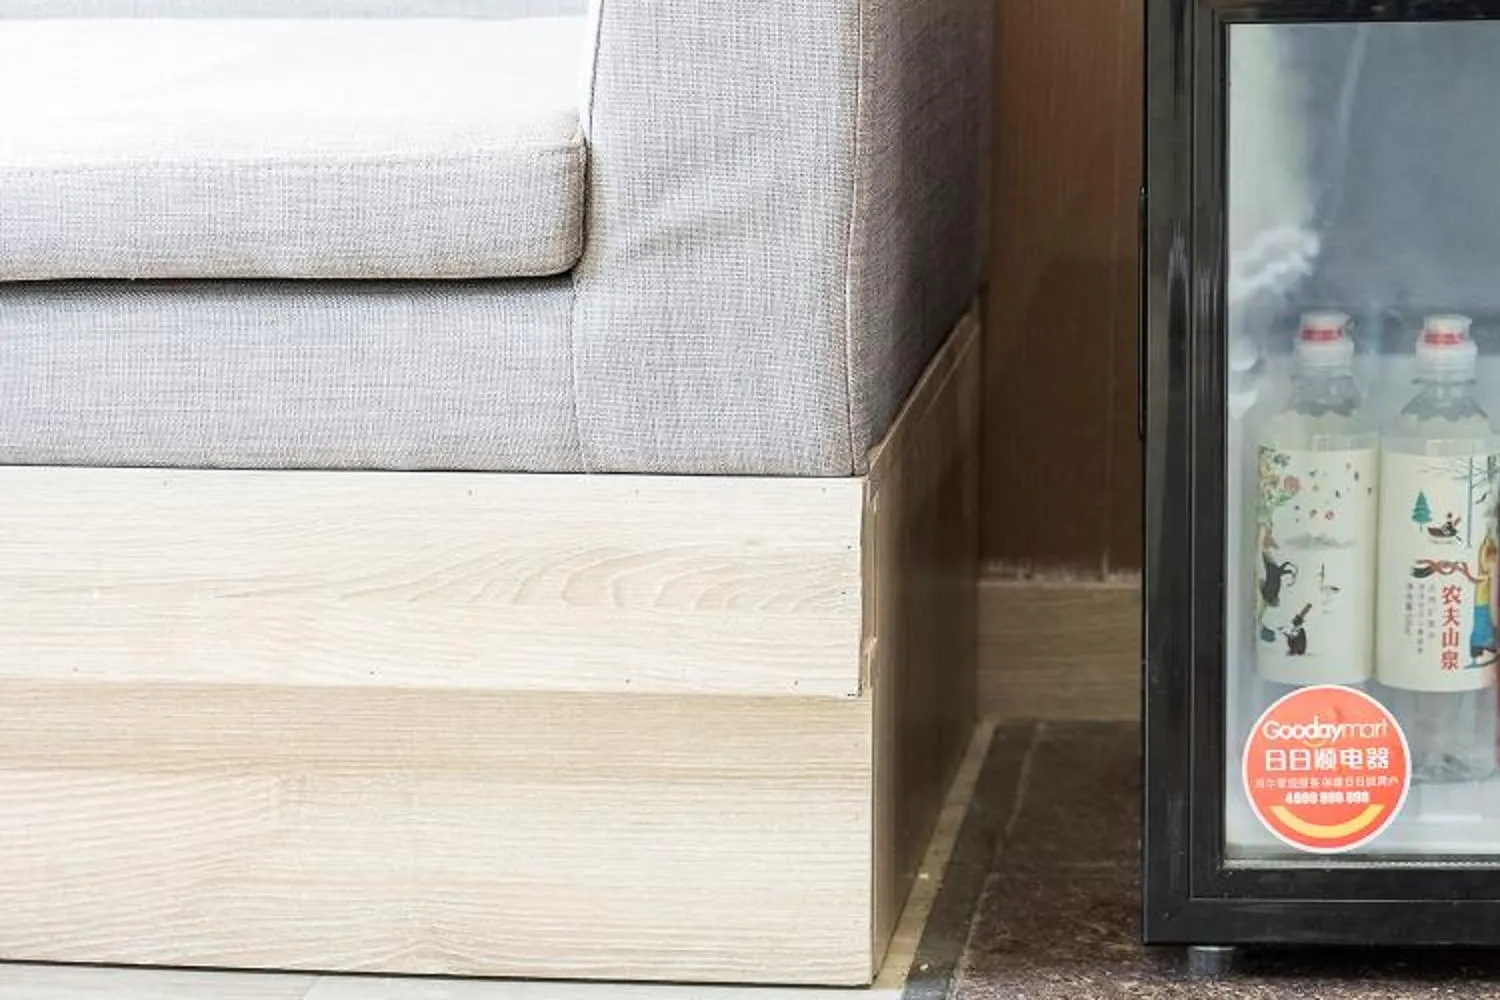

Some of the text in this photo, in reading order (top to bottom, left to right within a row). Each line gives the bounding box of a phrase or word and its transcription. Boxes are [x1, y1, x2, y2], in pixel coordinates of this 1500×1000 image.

[1441, 584, 1462, 672] 农夫山泉
[1262, 715, 1389, 744] Goodaymart
[1264, 747, 1390, 771] 日日顺电器
